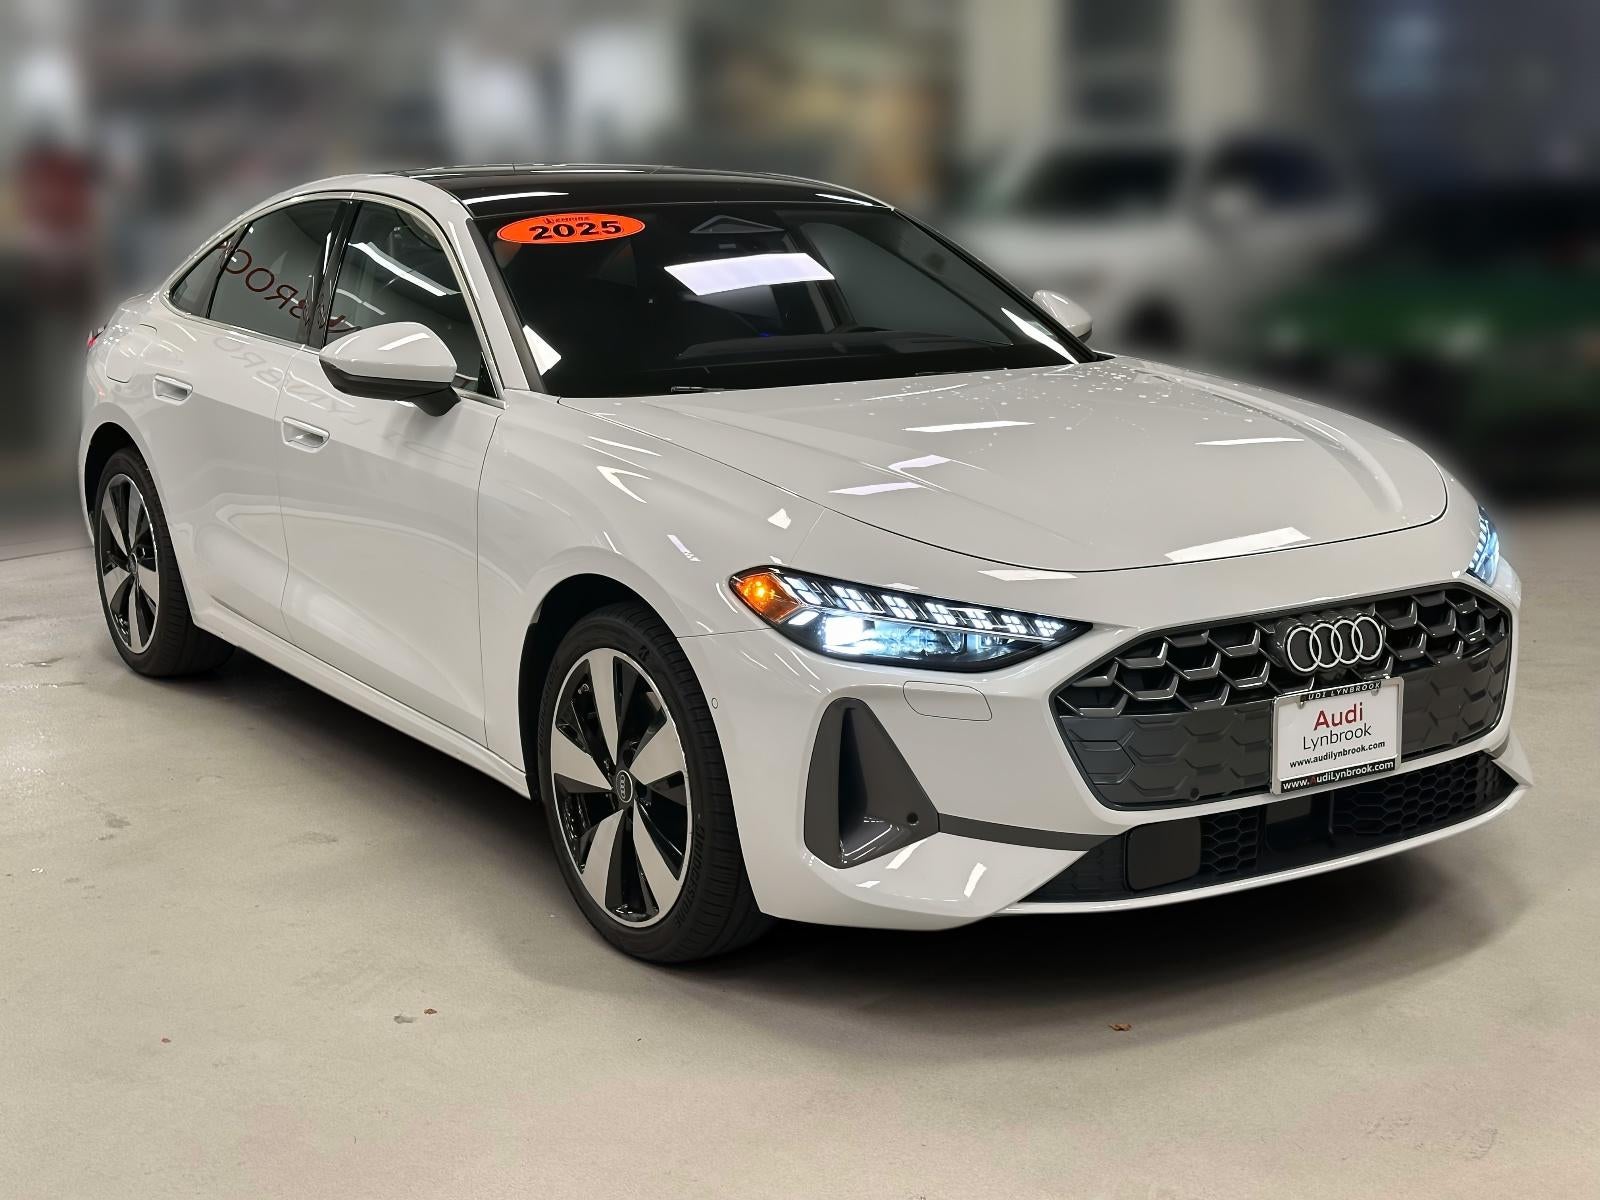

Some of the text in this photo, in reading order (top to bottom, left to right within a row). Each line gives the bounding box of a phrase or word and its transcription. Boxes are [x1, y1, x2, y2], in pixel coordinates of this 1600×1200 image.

[529, 220, 622, 241] 2025
[1330, 681, 1381, 697] LYNBROOK
[1313, 701, 1364, 731] Audi
[1303, 722, 1372, 752] Lynbrook
[1289, 740, 1386, 769] www.audilynbrook.com
